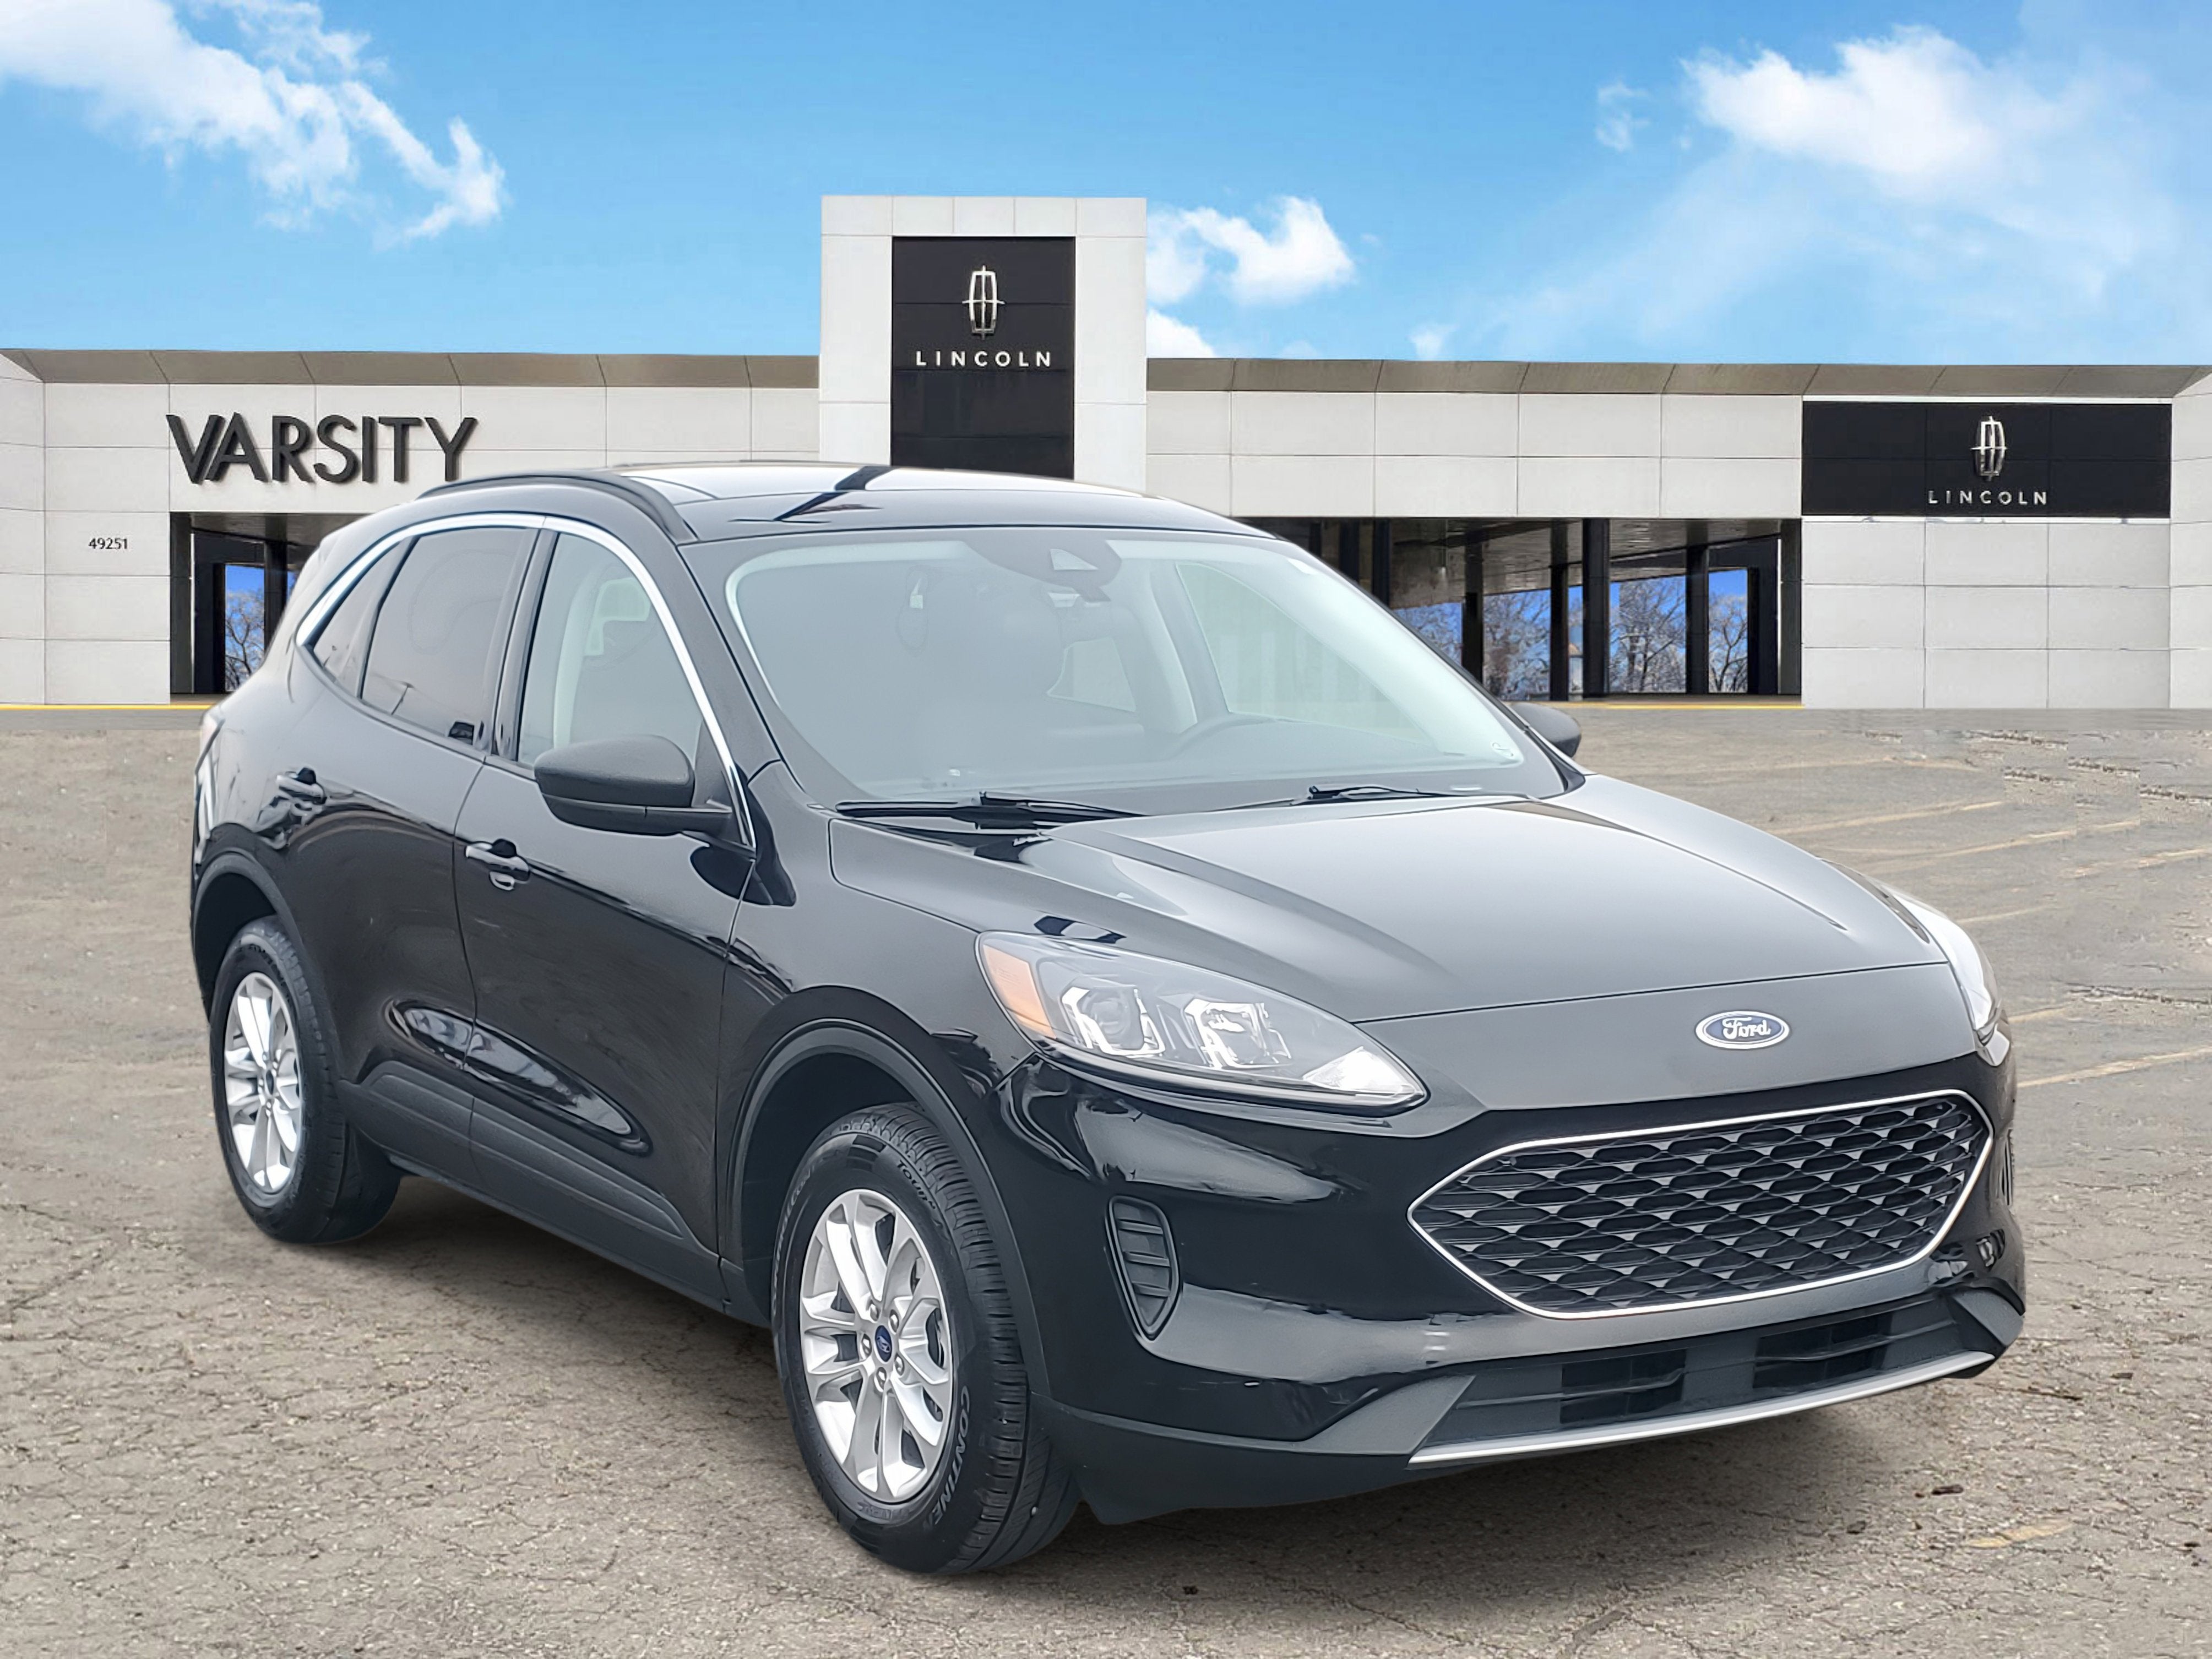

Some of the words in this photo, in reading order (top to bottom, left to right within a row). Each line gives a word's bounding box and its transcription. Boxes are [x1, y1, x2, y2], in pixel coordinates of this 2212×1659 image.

[916, 351, 1051, 367] LINCOLN
[166, 412, 478, 484] VARSITY
[1928, 490, 2047, 505] LINCOLN
[88, 537, 128, 550] 49251
[1722, 1016, 1771, 1040] Ford
